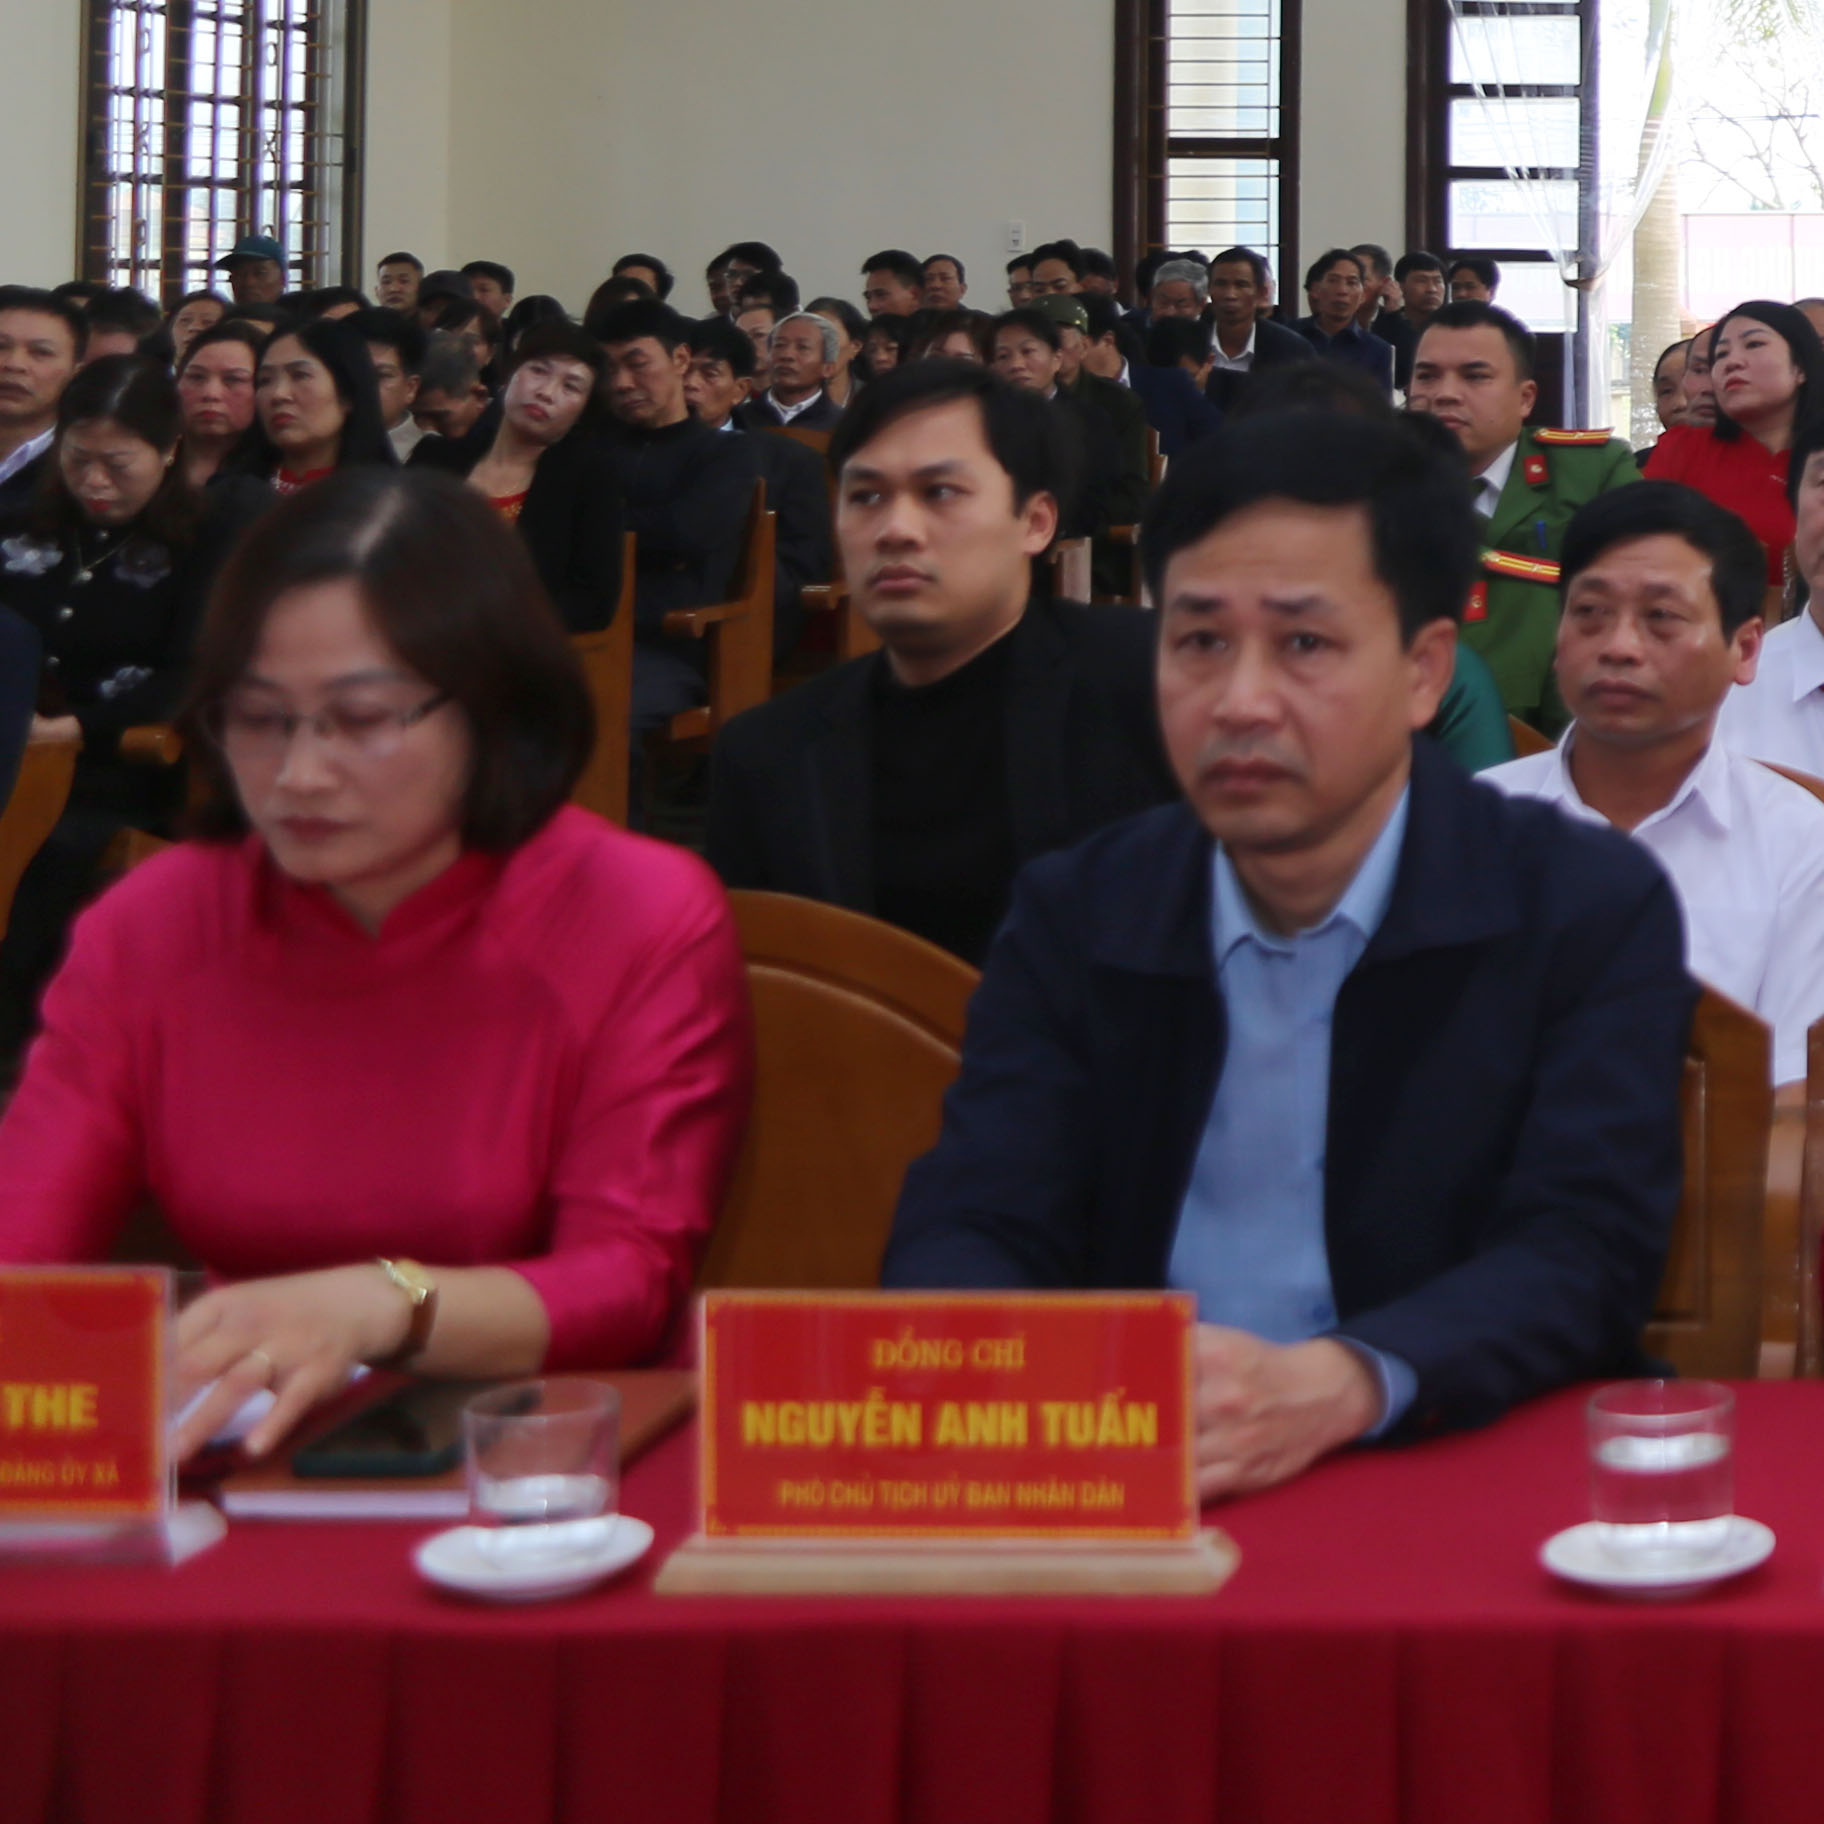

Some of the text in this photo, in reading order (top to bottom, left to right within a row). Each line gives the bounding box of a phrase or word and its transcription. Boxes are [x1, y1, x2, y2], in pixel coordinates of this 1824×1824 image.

[742, 1387, 1158, 1445] NGUYỄN ANH TUẤN
